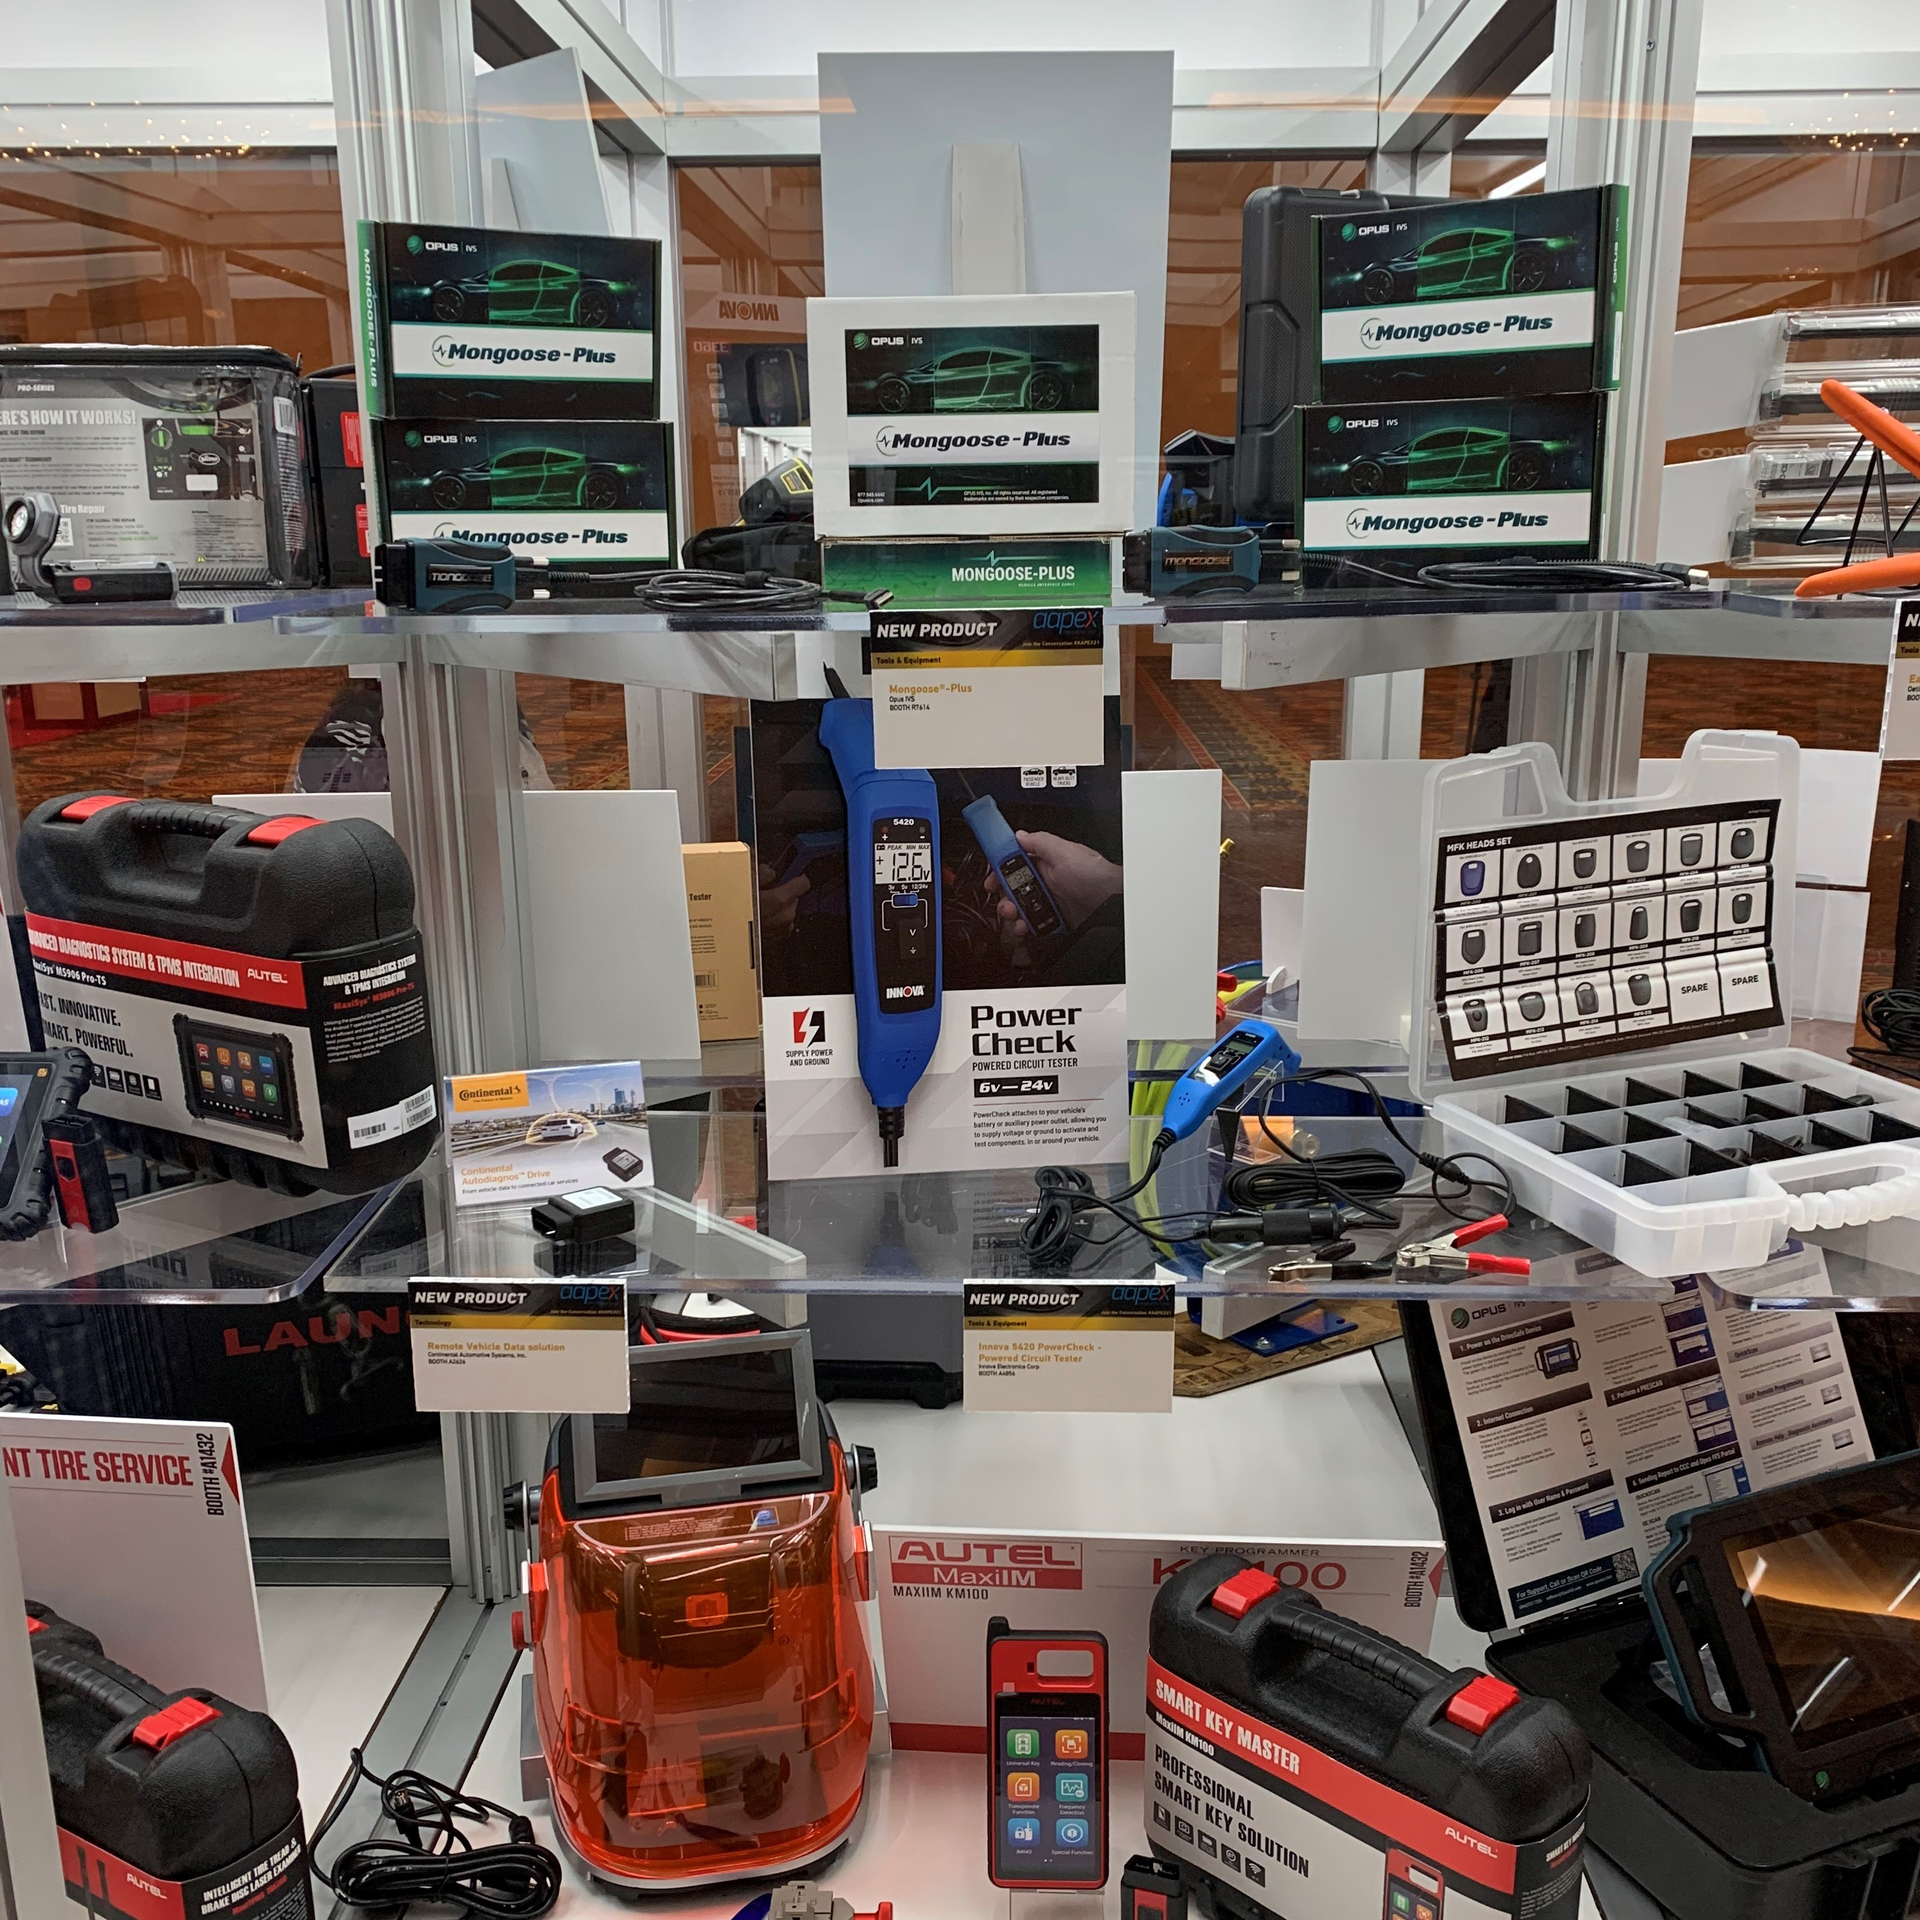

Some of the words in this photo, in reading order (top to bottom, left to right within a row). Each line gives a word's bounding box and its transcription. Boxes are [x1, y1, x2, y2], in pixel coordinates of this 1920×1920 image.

[1358, 223, 1389, 236] OPUS
[1397, 223, 1408, 231] IVS
[425, 242, 458, 252] OPUS
[466, 244, 477, 252] IVS
[363, 249, 378, 388] MONGOOSE-PLUS
[1375, 314, 1553, 342] Mongoose-Plus
[871, 336, 904, 345] OPUS
[448, 344, 616, 364] Mongoose-Plus
[18, 384, 55, 392] PRO-SERIES
[31, 410, 63, 425] HOW
[66, 410, 78, 424] IT
[80, 410, 136, 425] WORKS!
[1346, 418, 1378, 428] OPUS
[1386, 418, 1398, 426] IVS
[424, 435, 457, 443] OPUS
[466, 435, 477, 443] IVS
[892, 431, 1071, 452] Mongoose-Plus
[60, 504, 76, 514] Tire
[78, 504, 105, 514] Repair
[1362, 511, 1549, 532] Mongoose-Plus
[952, 566, 1075, 582] MONGOOSE-PLUS
[877, 624, 916, 638] NEW
[920, 623, 997, 637] PRODUCT
[1033, 611, 1098, 634] aapex
[904, 656, 941, 665] Equipment
[1447, 843, 1465, 852] MFK
[1466, 839, 1495, 849] HEADS
[1497, 837, 1512, 846] SET
[689, 893, 712, 901] Tester
[59, 937, 111, 963] DIAGNOSTICS
[112, 950, 145, 971] SYSTEM
[148, 959, 155, 971] &
[157, 957, 182, 977] TPMS
[183, 961, 240, 988] INTEGRATION
[247, 968, 288, 984] AUTEL
[1732, 975, 1758, 986] SPARE
[886, 985, 925, 999] INNOVA
[1681, 983, 1708, 994] SPARE
[40, 992, 56, 1012] AST.
[58, 997, 121, 1027] INNOVATIVE.
[971, 1006, 1082, 1029] Power
[43, 1020, 72, 1043] MART.
[75, 1028, 133, 1058] POWERFUL.
[972, 1030, 1077, 1056] Check
[786, 1050, 809, 1058] SUPPLY
[804, 1058, 829, 1066] GROUND
[973, 1061, 1011, 1071] POWERED
[1014, 1060, 1045, 1069] CIRCUIT
[1048, 1058, 1078, 1067] TESTER
[459, 1087, 512, 1101] Continental
[974, 1121, 995, 1129] battery
[1071, 1116, 1094, 1124] allowing
[1033, 1128, 1054, 1136] ground
[461, 1164, 513, 1176] Continental
[518, 1181, 546, 1189] connected
[415, 1292, 450, 1303] NEW
[454, 1292, 527, 1304] PRODUCT
[560, 1286, 620, 1304] aapex
[970, 1294, 1005, 1305] NEW
[1008, 1294, 1080, 1305] PRODUCT
[1112, 1287, 1172, 1305] aapex
[223, 1306, 410, 1356] LAUN
[415, 1319, 452, 1327] Technology
[993, 1320, 1027, 1328] Equipment
[428, 1342, 464, 1350] Remote
[466, 1342, 500, 1351] Vehicle
[504, 1343, 525, 1351] Data
[528, 1343, 565, 1351] solution
[1038, 1343, 1094, 1351] PowerCheck
[1483, 1414, 1504, 1425] Internet
[1505, 1406, 1534, 1418] Connection
[196, 1433, 217, 1474] #A1432
[2, 1448, 31, 1478] NT
[36, 1448, 90, 1480] TIRE
[94, 1452, 194, 1486] SERVICE
[202, 1476, 224, 1516] BOOTH
[898, 1541, 1075, 1566] AUTEL
[1215, 1546, 1320, 1556] PROGRAMMER
[1408, 1551, 1429, 1579] #A1432
[933, 1567, 1036, 1587] MaxiIM
[1549, 1579, 1560, 1588] Call
[1567, 1574, 1580, 1582] Scan
[1581, 1570, 1589, 1578] QR
[1589, 1566, 1602, 1575] Code
[893, 1585, 941, 1599] MAXIIM
[947, 1587, 989, 1600] KM100
[1404, 1580, 1424, 1607] BOOTH
[1156, 1679, 1202, 1722] SMART
[1206, 1709, 1233, 1739] KEY
[1237, 1726, 1300, 1775] MASTER
[1156, 1711, 1184, 1739] MaxiIM
[1185, 1732, 1215, 1756] KM100
[1155, 1744, 1254, 1820] PROFESSIONAL
[1155, 1771, 1201, 1814] SMART
[1206, 1802, 1233, 1833] KEY
[1238, 1822, 1309, 1878] SOLUTION
[1445, 1827, 1498, 1859] AUTEL
[204, 1871, 252, 1901] INTELLIGENT
[253, 1860, 269, 1878] TIRE
[269, 1845, 290, 1867] TREAD
[291, 1837, 297, 1846] &
[127, 1873, 167, 1899] AUTEL
[201, 1898, 230, 1915] BRAKE
[231, 1885, 249, 1903] DISC
[250, 1872, 272, 1893] LASER
